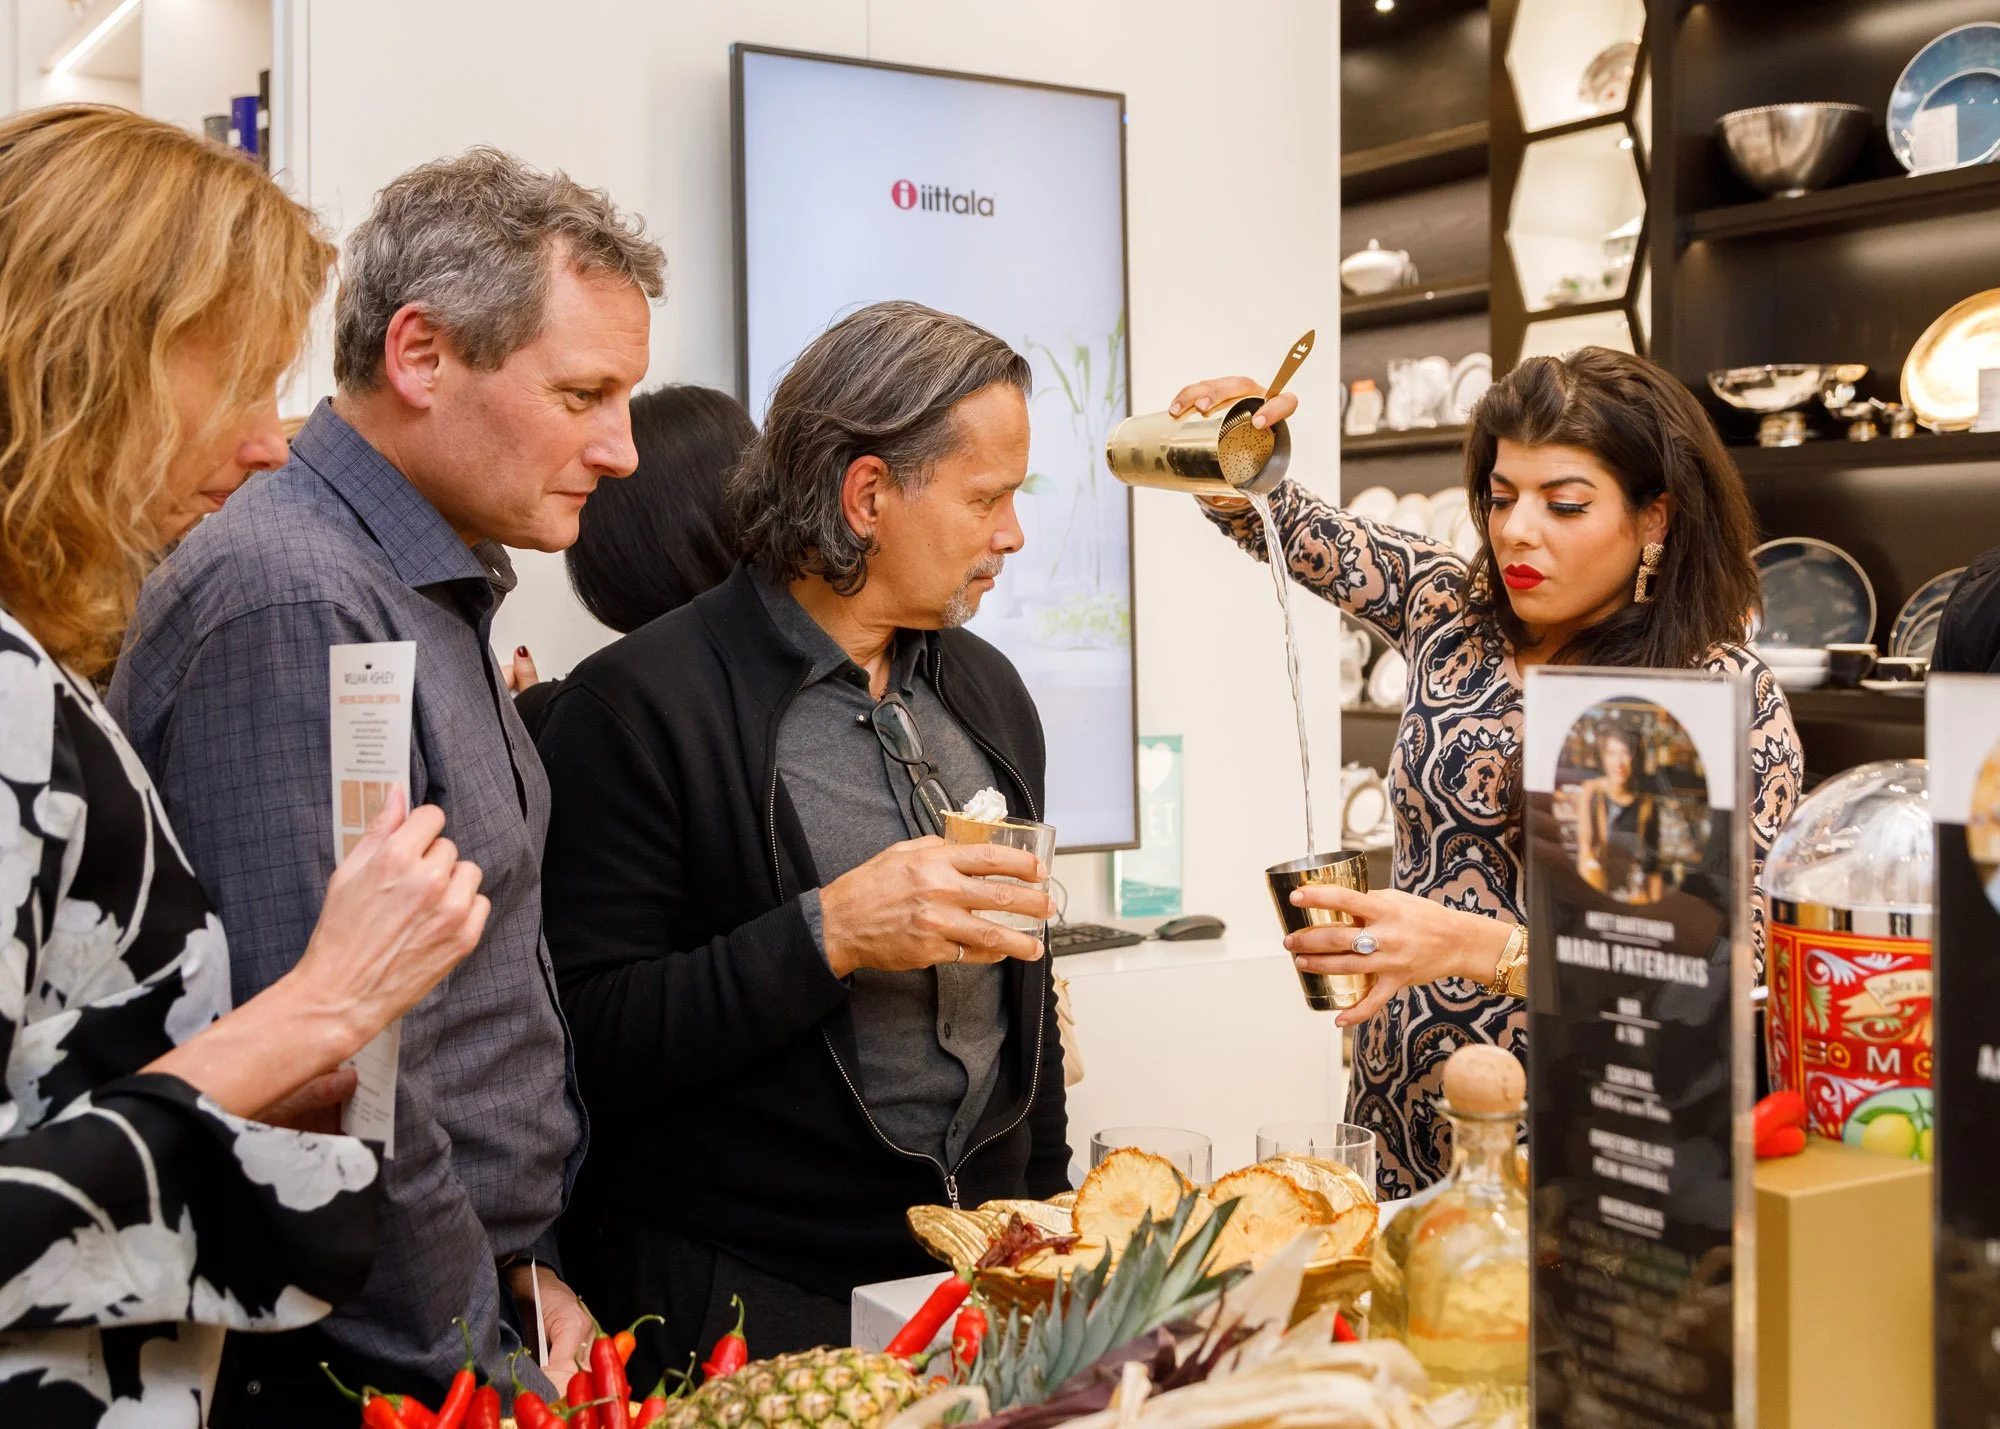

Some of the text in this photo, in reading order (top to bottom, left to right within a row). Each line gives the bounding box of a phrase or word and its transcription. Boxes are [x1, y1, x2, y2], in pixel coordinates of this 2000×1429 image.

[921, 184, 994, 216] iittala
[1556, 934, 1709, 988] MARIA PATERAKIS
